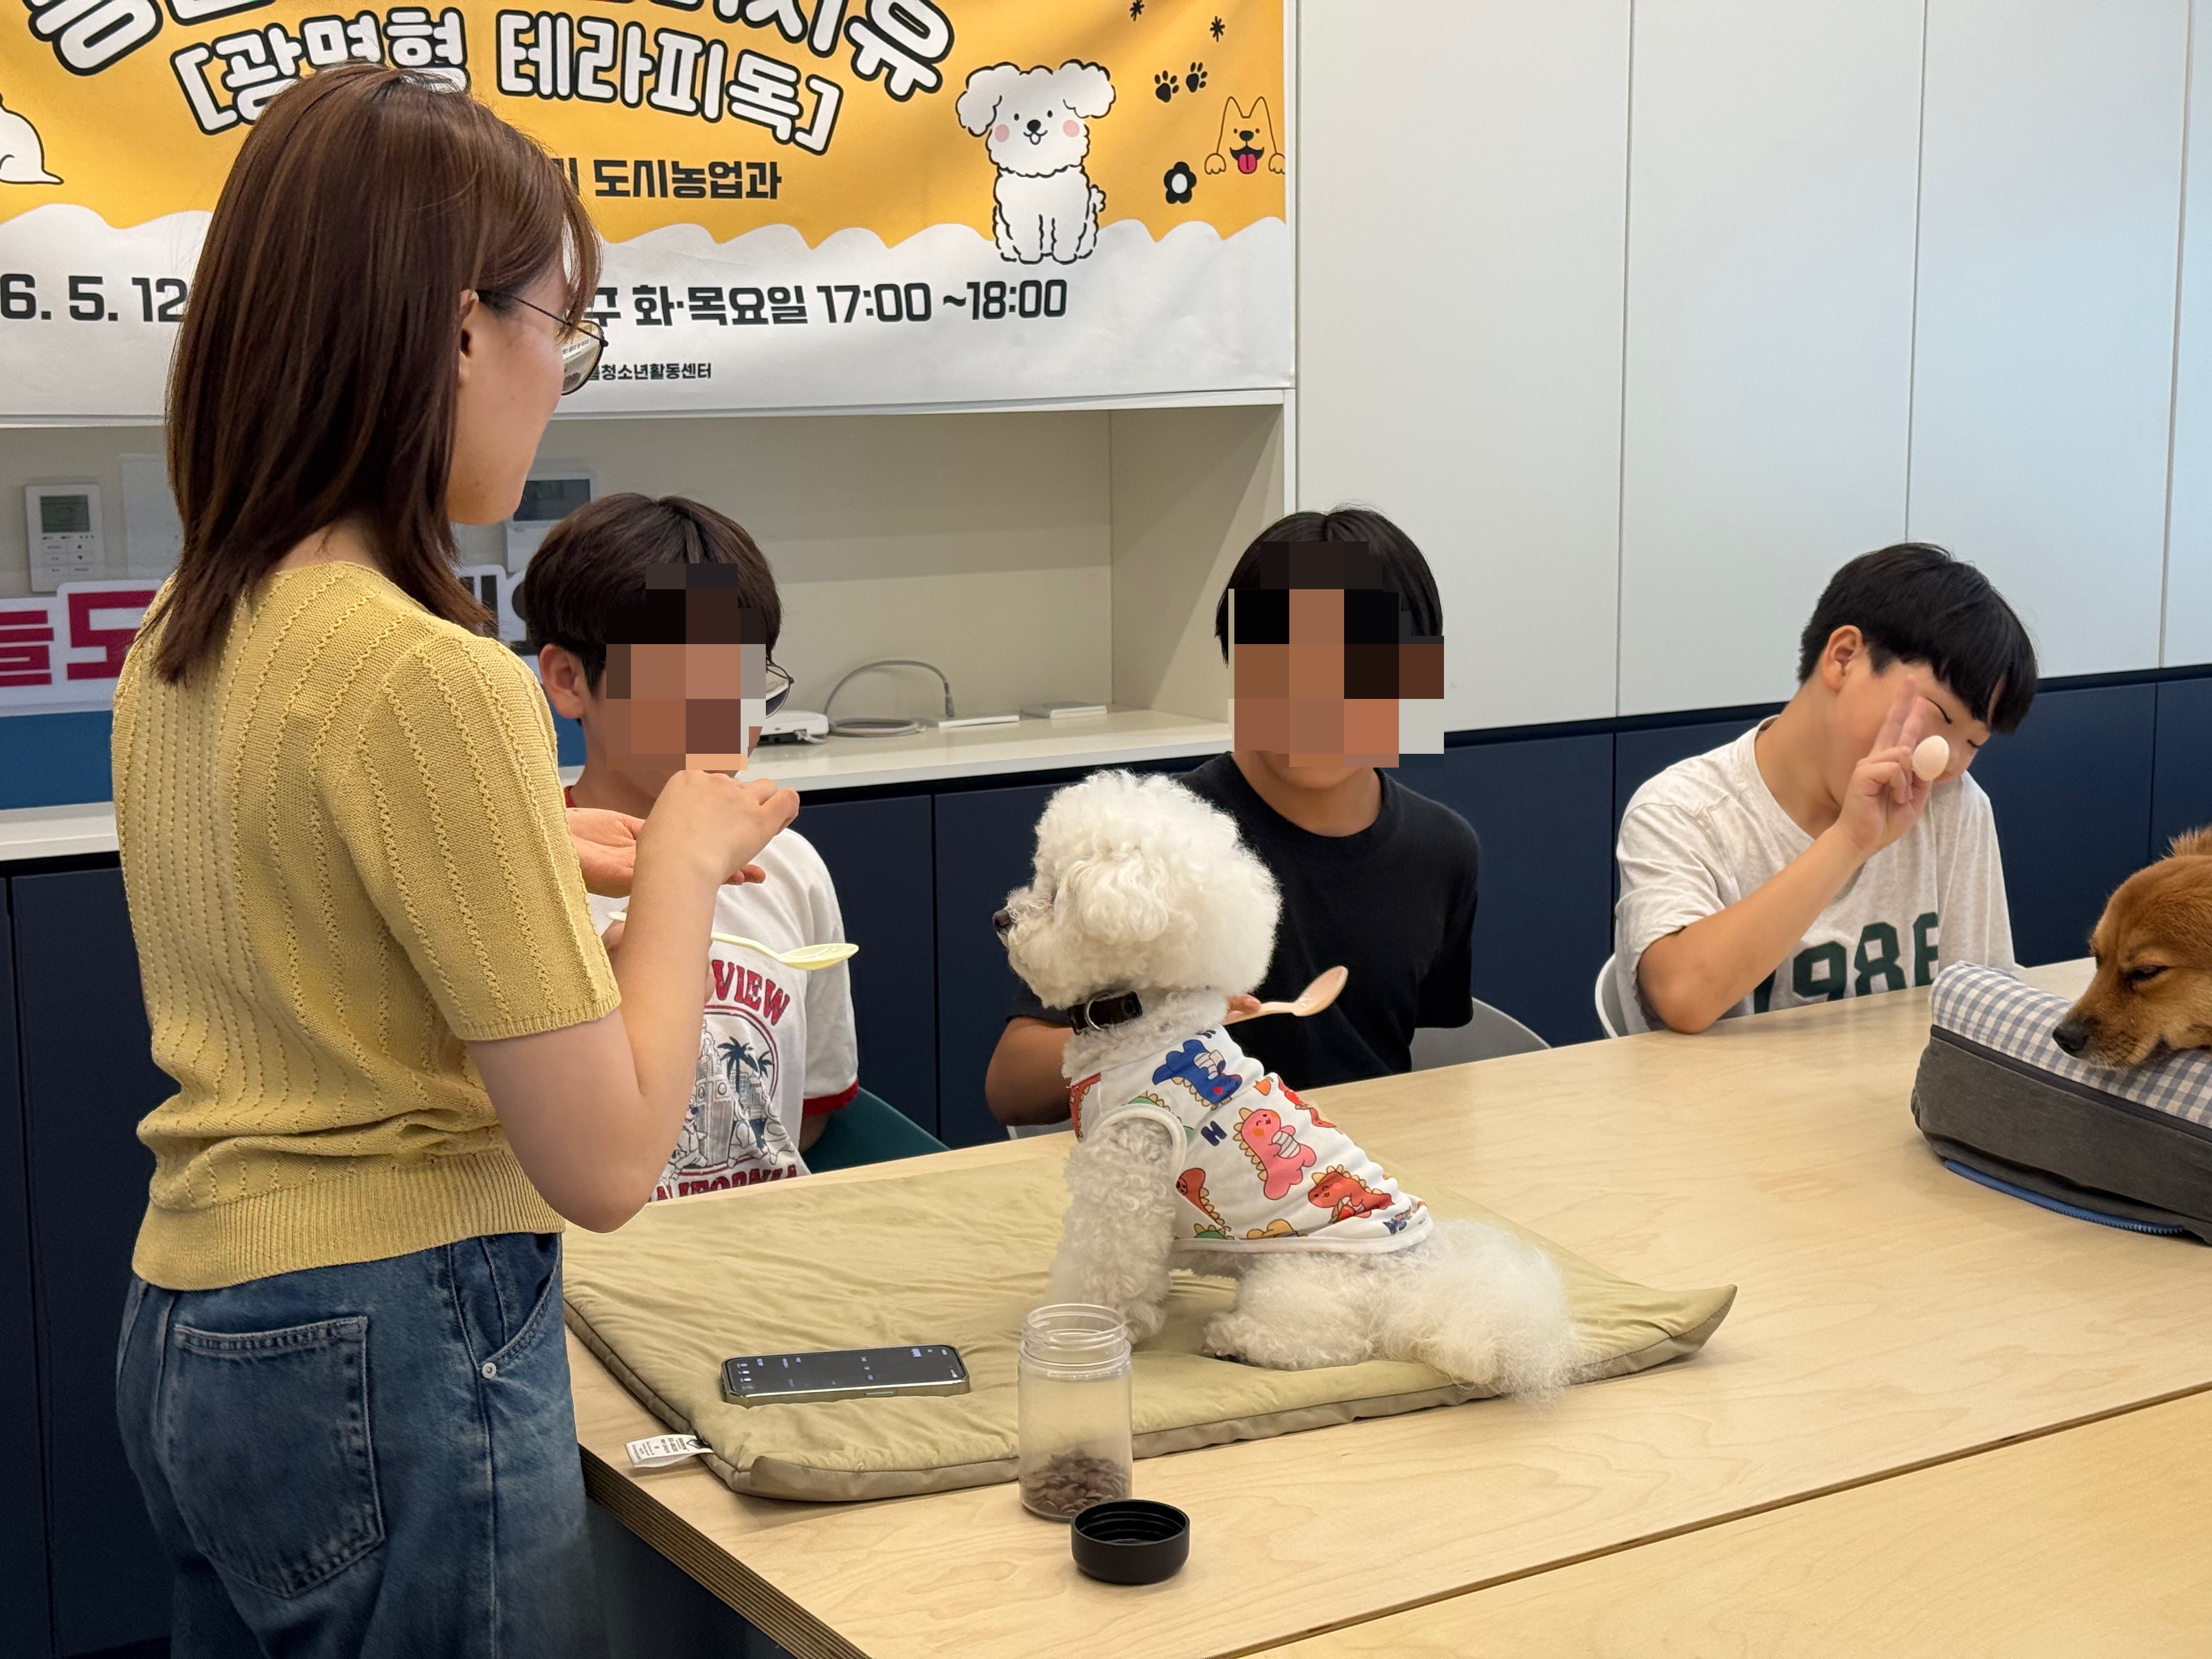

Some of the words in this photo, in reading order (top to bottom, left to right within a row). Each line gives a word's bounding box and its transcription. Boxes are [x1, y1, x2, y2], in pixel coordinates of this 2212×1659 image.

[496, 9, 844, 155] 테라피독]
[594, 160, 782, 200] 도시농업과
[68, 275, 119, 321] 5.
[632, 284, 808, 327] 화·목요일
[817, 282, 932, 324] 17:00
[943, 279, 1068, 320] ~18:00
